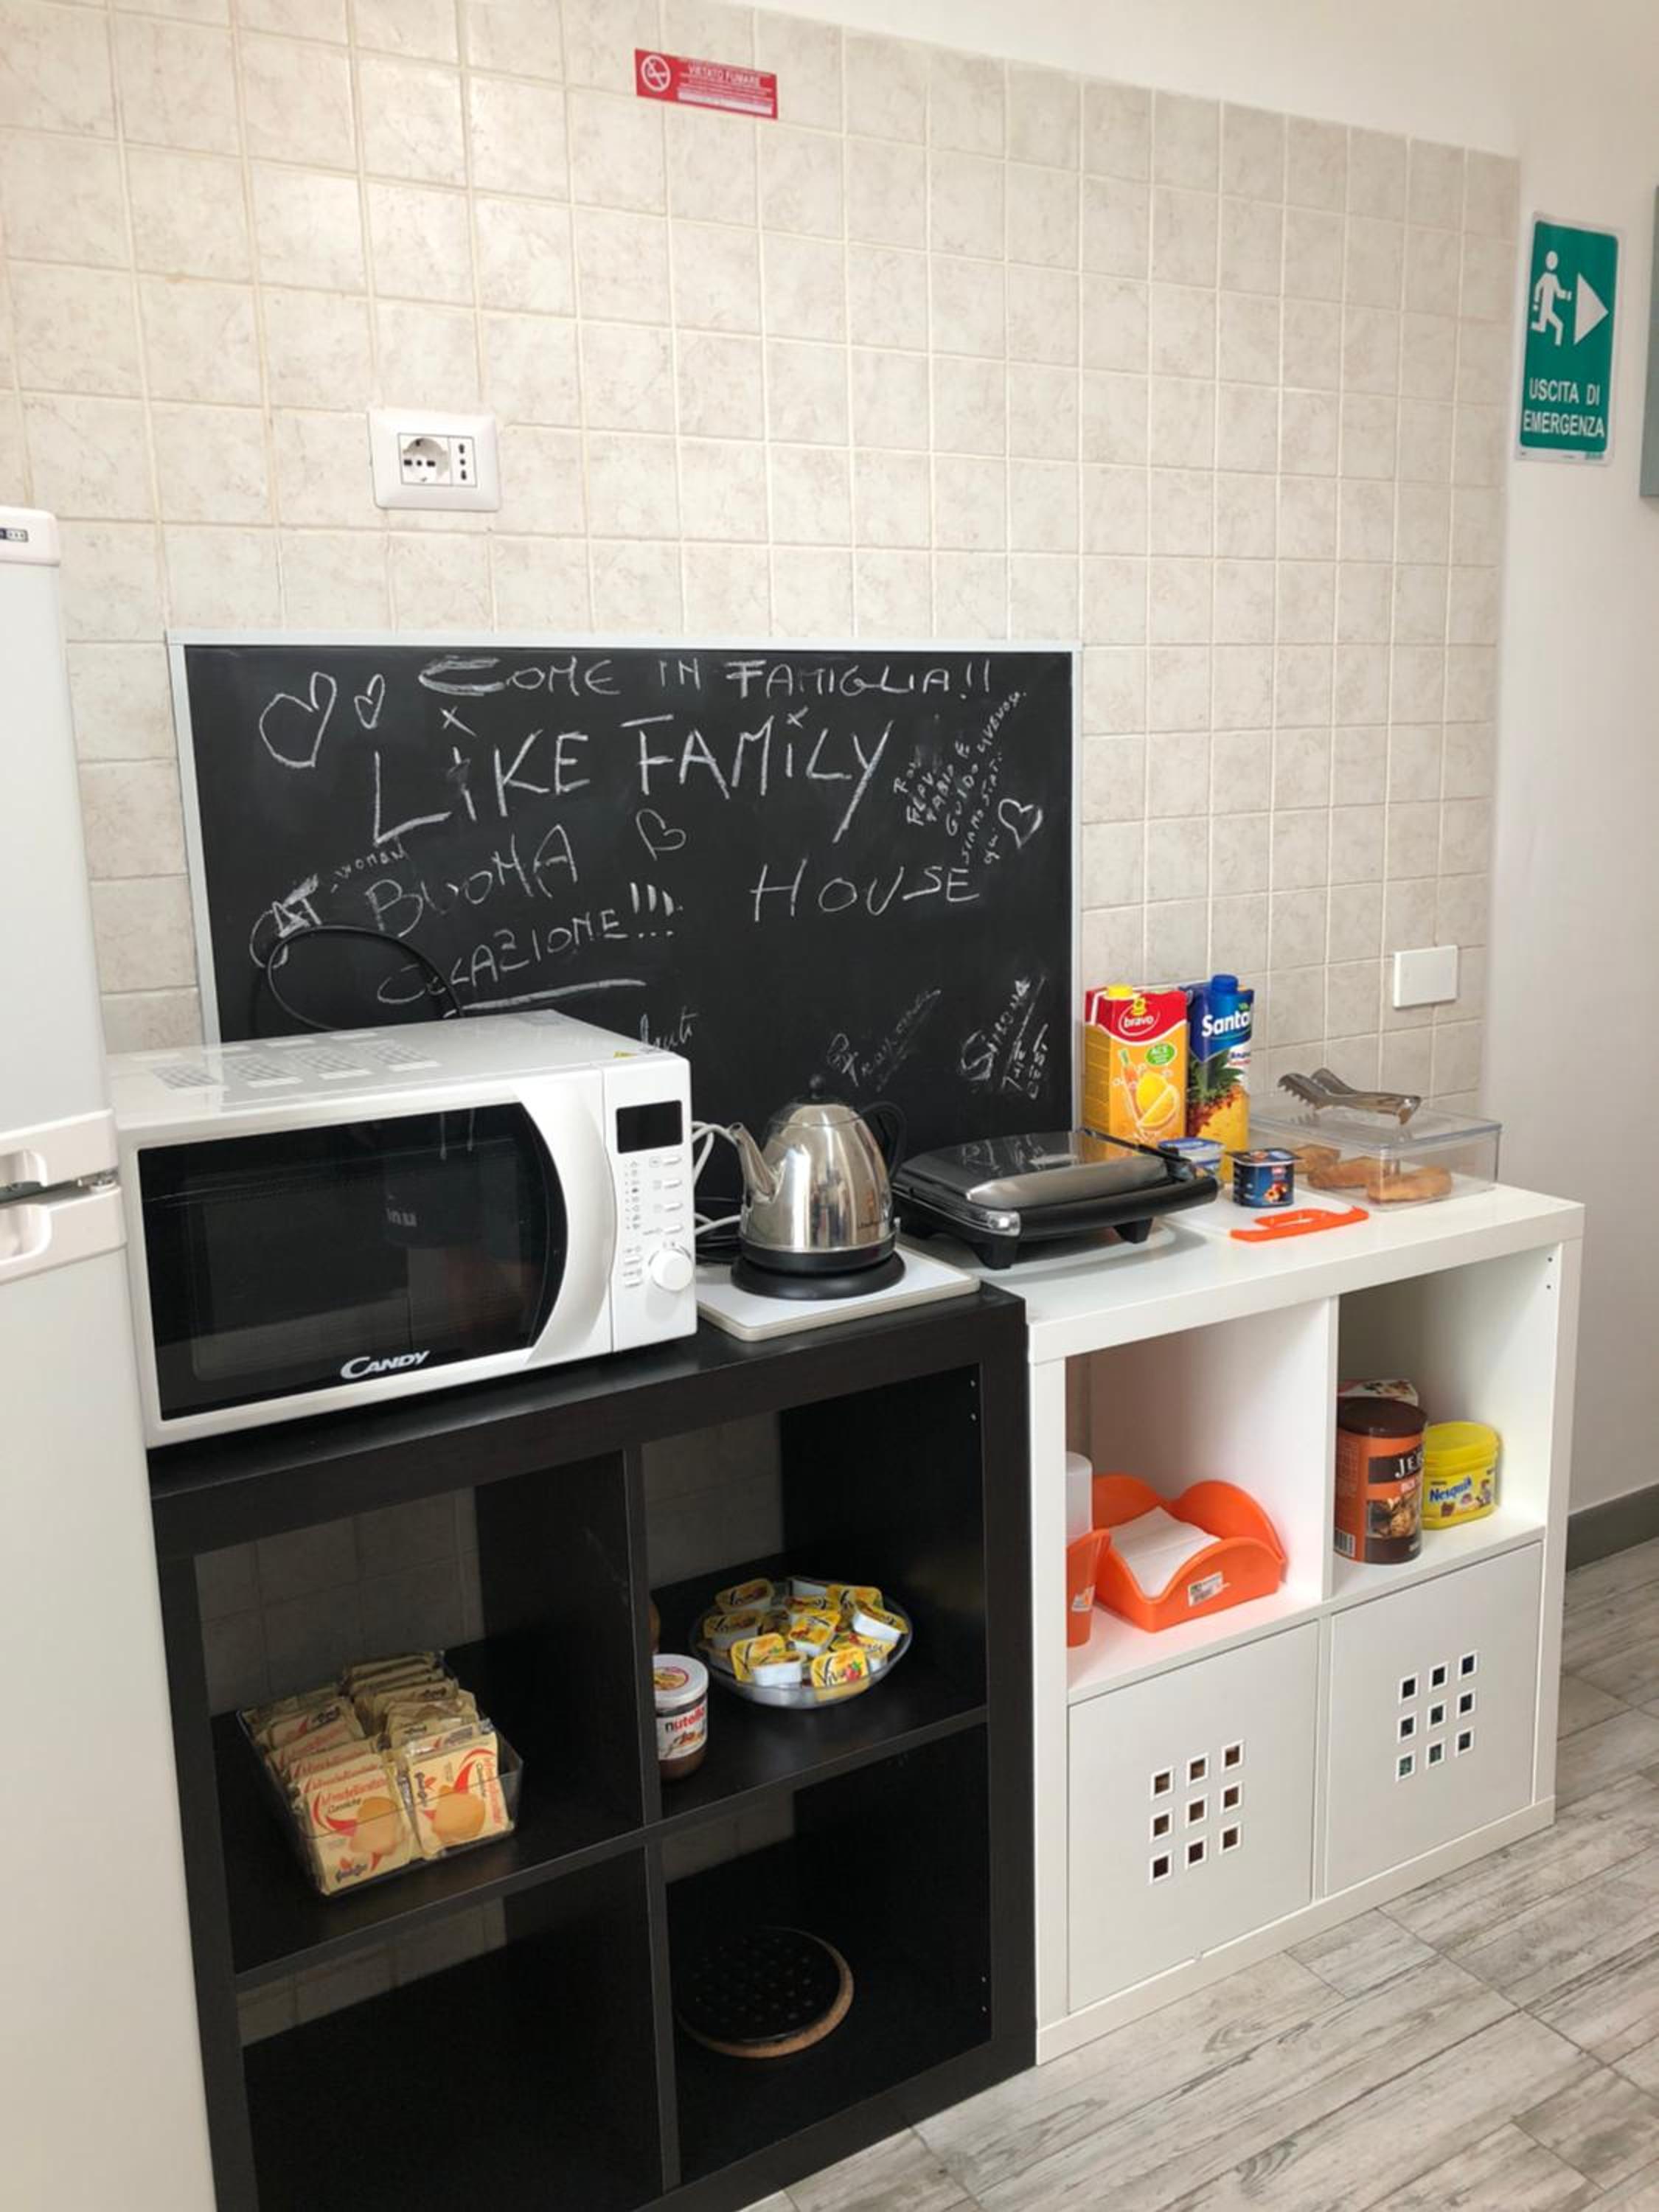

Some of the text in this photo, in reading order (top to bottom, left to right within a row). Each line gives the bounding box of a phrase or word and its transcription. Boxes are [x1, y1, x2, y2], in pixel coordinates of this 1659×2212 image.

[1529, 378, 1601, 406] USCITA DI
[1523, 410, 1605, 438] EMERGENZA
[418, 655, 621, 697] COME
[661, 657, 701, 691] IN
[750, 858, 981, 922] HOUSE
[1123, 1015, 1155, 1029] bravo
